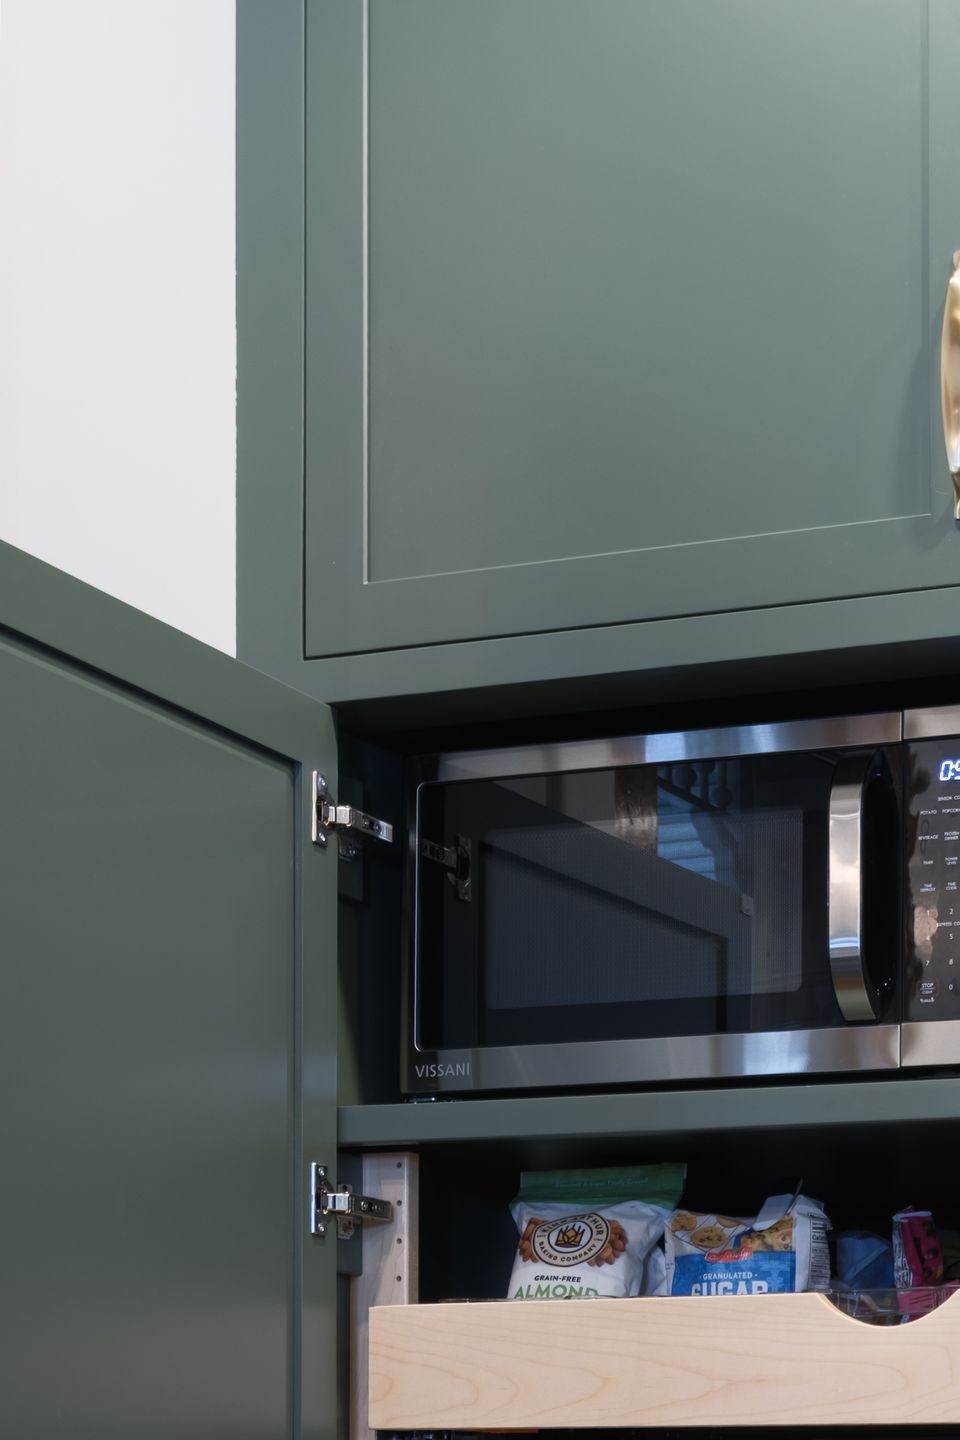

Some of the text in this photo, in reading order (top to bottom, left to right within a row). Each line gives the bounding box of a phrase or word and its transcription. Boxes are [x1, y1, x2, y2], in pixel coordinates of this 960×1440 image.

[948, 958, 954, 966] 8
[415, 1063, 470, 1078] VISSANI
[534, 1274, 582, 1284] GRAIN-FREE
[702, 1271, 753, 1280] GRANULATED
